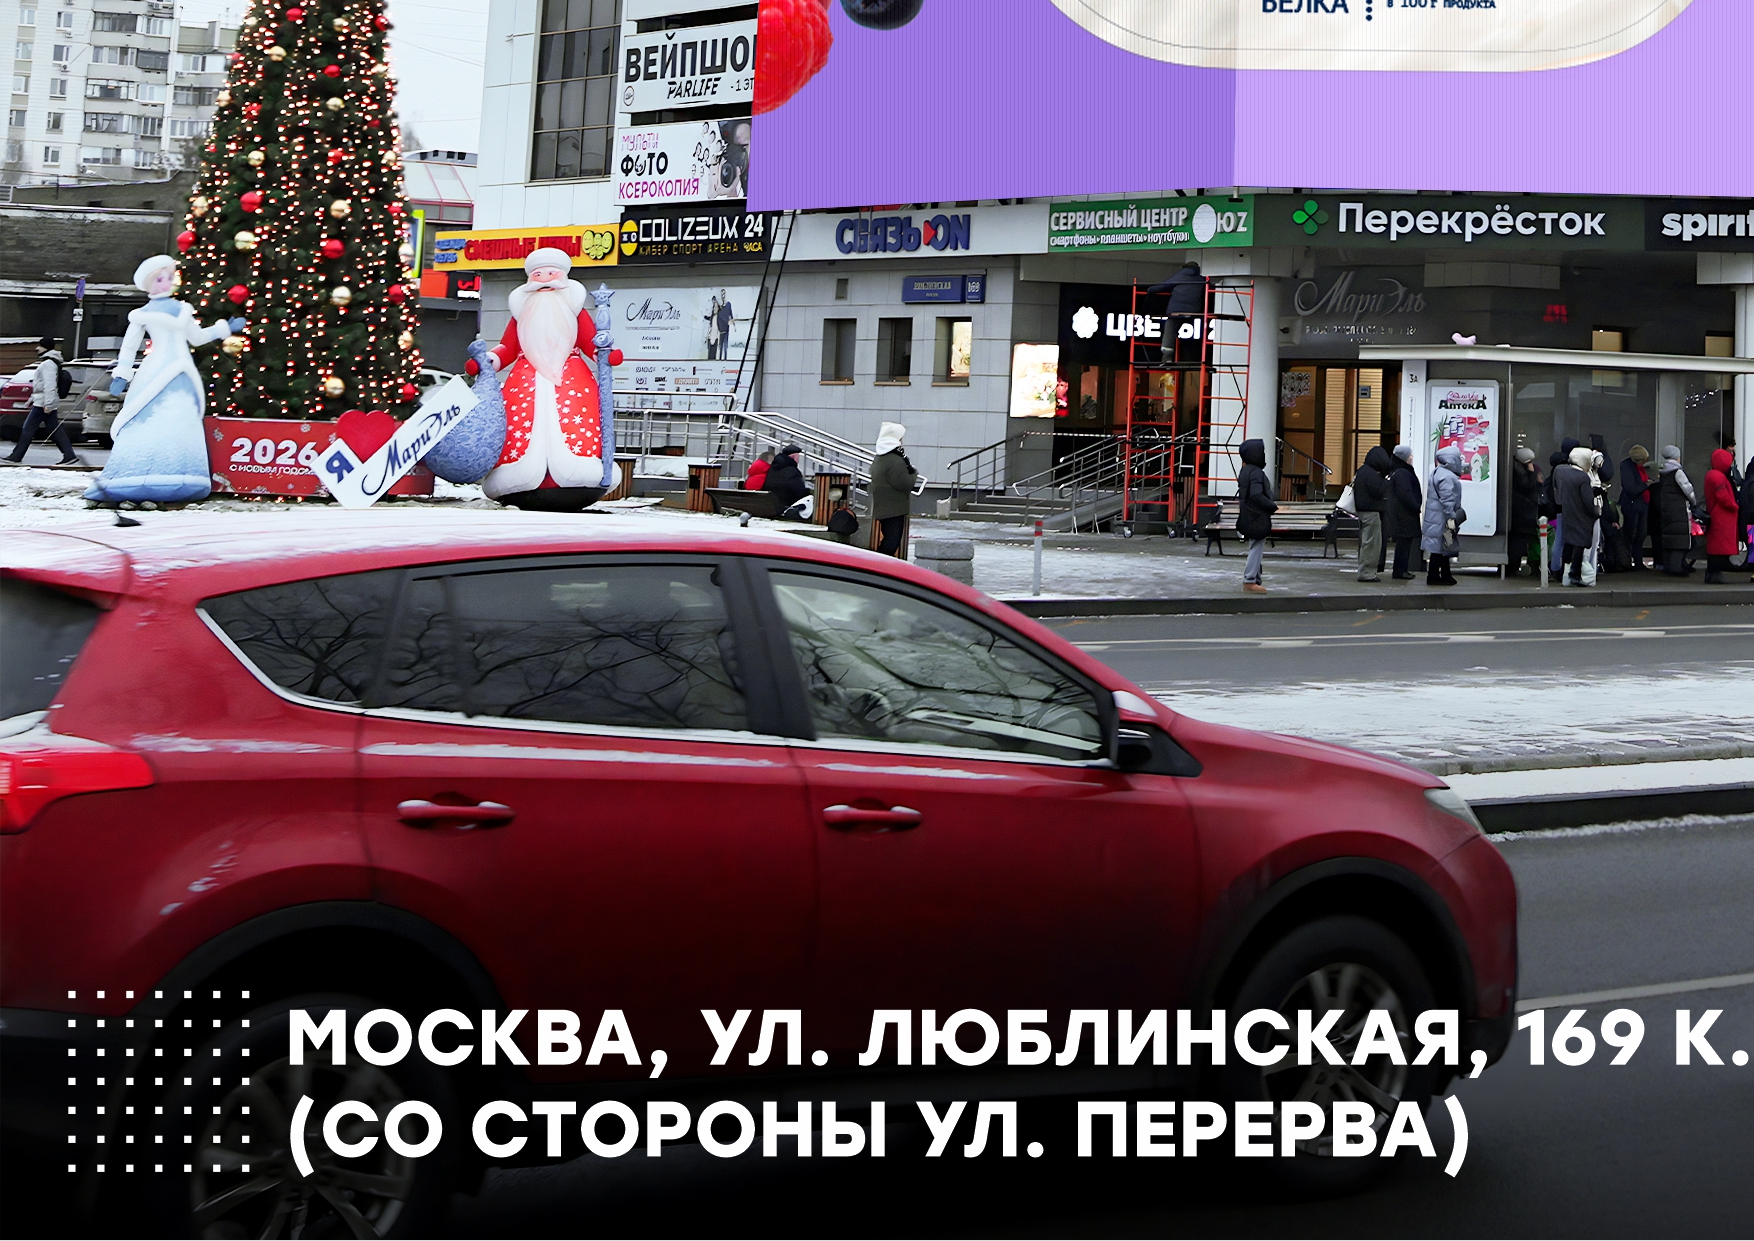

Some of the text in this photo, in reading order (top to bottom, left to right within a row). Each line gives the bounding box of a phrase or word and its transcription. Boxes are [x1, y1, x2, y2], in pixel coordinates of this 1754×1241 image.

[667, 77, 721, 99] PARLIFE
[621, 152, 668, 176] ФОТО
[619, 178, 699, 199] КСЕРОКОПИЯ
[639, 214, 764, 242] COLIZEUM 24
[1050, 205, 1188, 231] СЕРВИСНЫЙ ЦЕНТР
[1339, 202, 1606, 242] Перекрёсток
[673, 243, 702, 255] СПОРТ
[708, 242, 738, 254] АРЕНА
[230, 437, 318, 467] 2026
[325, 450, 354, 483] Я
